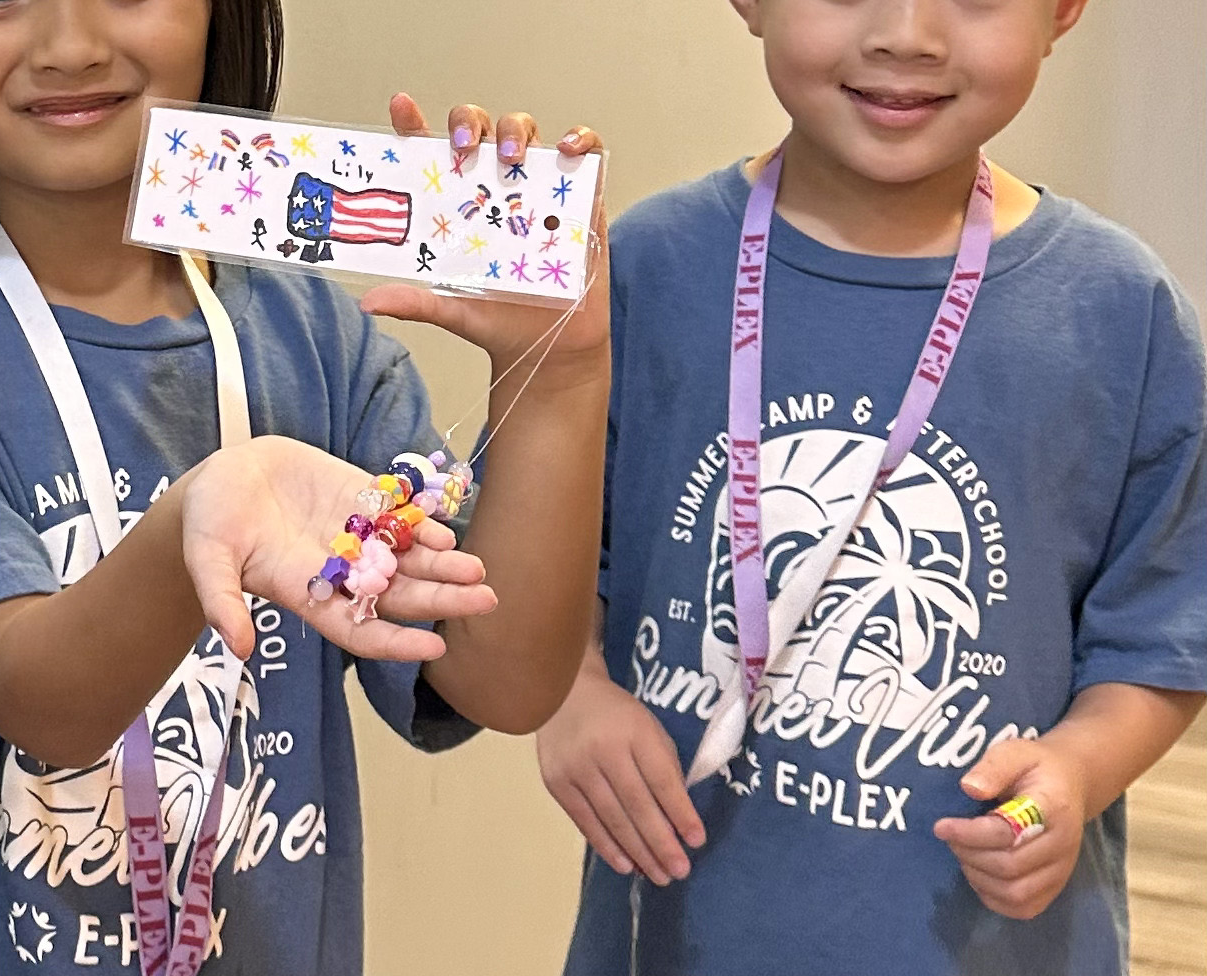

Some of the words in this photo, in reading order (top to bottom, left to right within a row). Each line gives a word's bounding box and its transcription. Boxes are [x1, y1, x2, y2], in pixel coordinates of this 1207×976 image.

[332, 158, 374, 184] Lily
[734, 234, 766, 353] E-PLEX
[918, 262, 982, 387] E-PLEX
[760, 393, 835, 429] AMP
[852, 395, 873, 426] &
[732, 439, 761, 565] E-PLEX
[667, 598, 696, 623] EST.
[958, 651, 1007, 676] 2020
[775, 760, 911, 832] E-PLEX
[128, 816, 169, 976] E-PLEX
